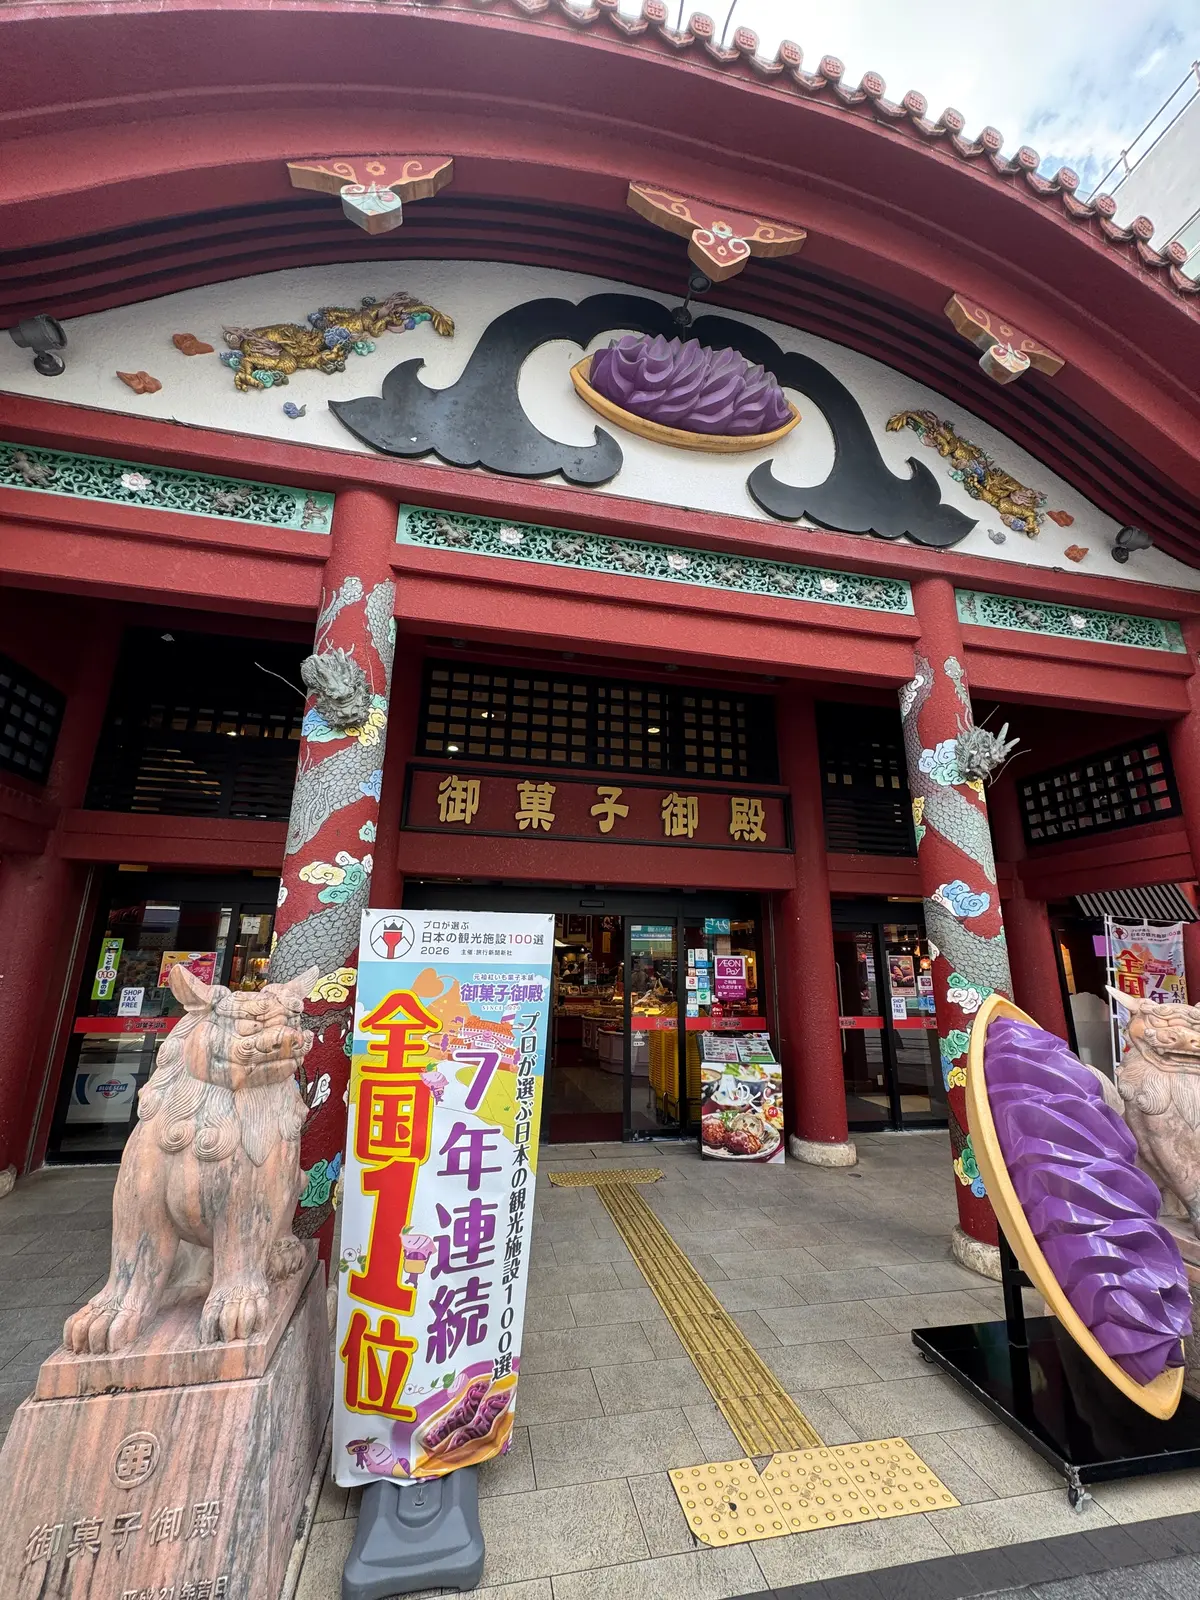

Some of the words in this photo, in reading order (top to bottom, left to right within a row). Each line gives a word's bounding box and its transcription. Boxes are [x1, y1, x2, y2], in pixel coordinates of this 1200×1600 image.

[437, 775, 767, 842] 御菓子御殿
[420, 946, 450, 955] 2026
[421, 932, 545, 945] 日本の観光施設100選
[423, 921, 470, 930] プロが選ぶ
[460, 983, 543, 1002] 御菓子御殿
[341, 991, 442, 1423] 全国1位
[425, 1052, 501, 1364] 7年連続
[491, 1012, 540, 1382] プロが選ぶ日本の観光施設100選
[25, 1502, 221, 1564] 御菓子御殿
